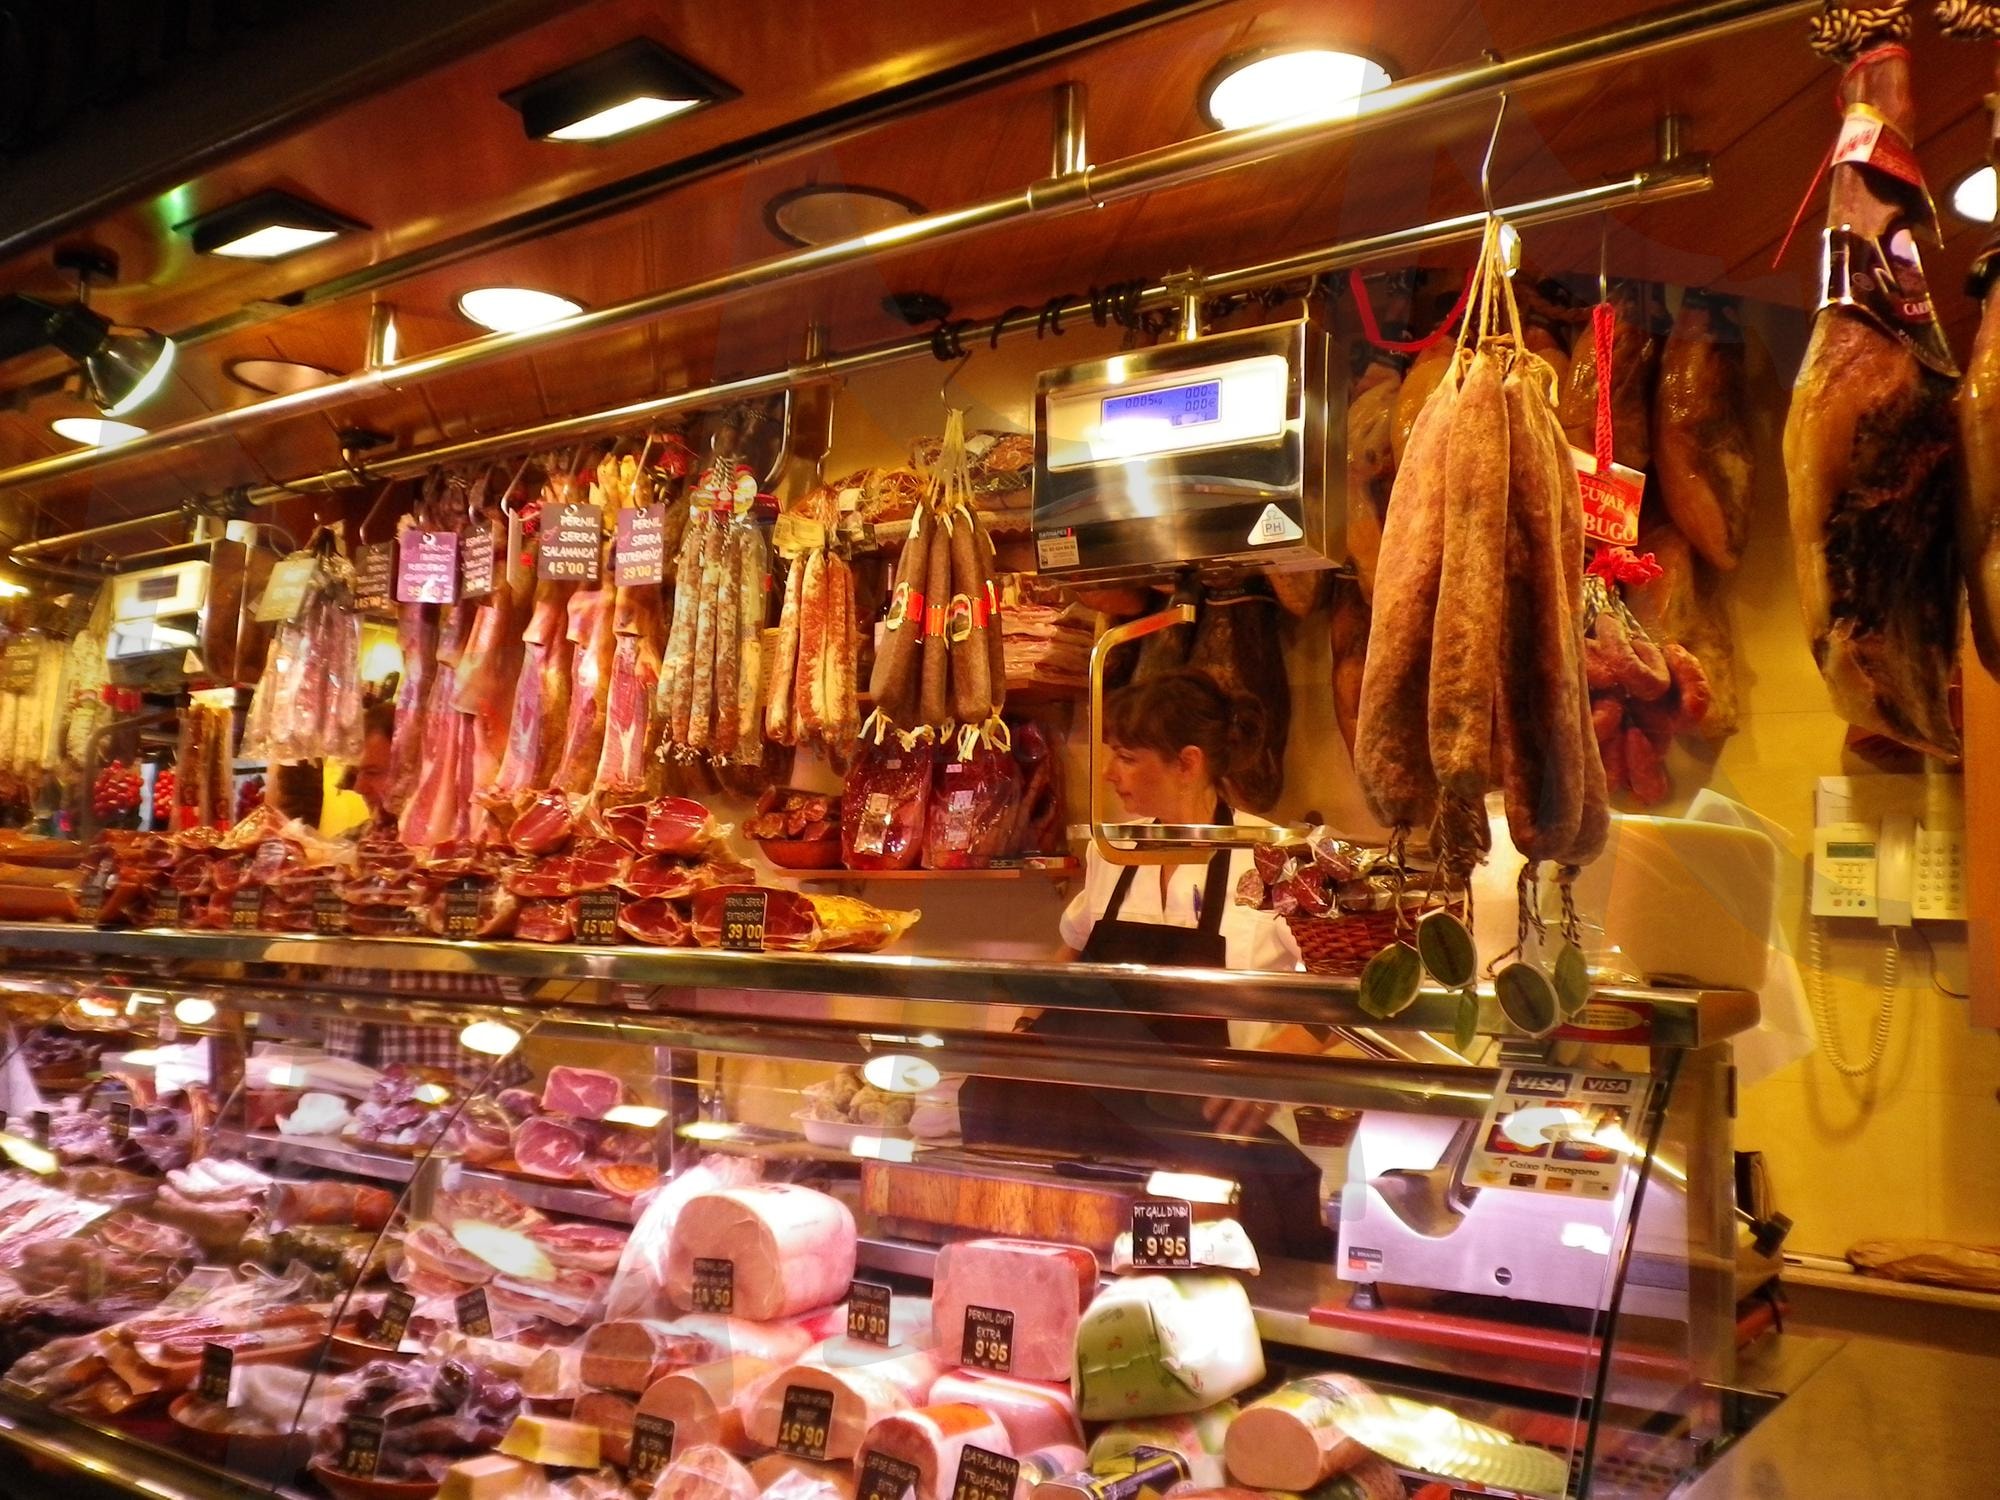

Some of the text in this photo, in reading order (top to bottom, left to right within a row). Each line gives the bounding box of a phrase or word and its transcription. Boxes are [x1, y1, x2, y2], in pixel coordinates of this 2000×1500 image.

[560, 515, 598, 528] PERNIL
[632, 517, 662, 530] PERNIL
[1265, 522, 1281, 533] PH
[559, 531, 597, 543] SERRA
[631, 532, 662, 547] SERRA
[548, 561, 584, 576] 45'00
[583, 919, 615, 934] 45'00
[728, 923, 763, 939] 39'00
[1517, 1076, 1566, 1092] VISA
[1588, 1079, 1627, 1092] VISA
[1508, 1160, 1600, 1177] Caixa Tarragona
[1133, 1206, 1145, 1218] PIT
[1145, 1206, 1167, 1219] GALL
[1152, 1223, 1170, 1235] CUIT
[1146, 1236, 1187, 1257] 9'95
[849, 1312, 886, 1336] 10'90
[967, 1308, 1013, 1326] PERNIL CUIT
[976, 1326, 1001, 1340] EXTRA
[975, 1340, 1008, 1362] 9'95
[780, 1420, 824, 1448] 16'90
[963, 1449, 1017, 1479] CATALANA
[964, 1469, 1009, 1496] TRUFADA
